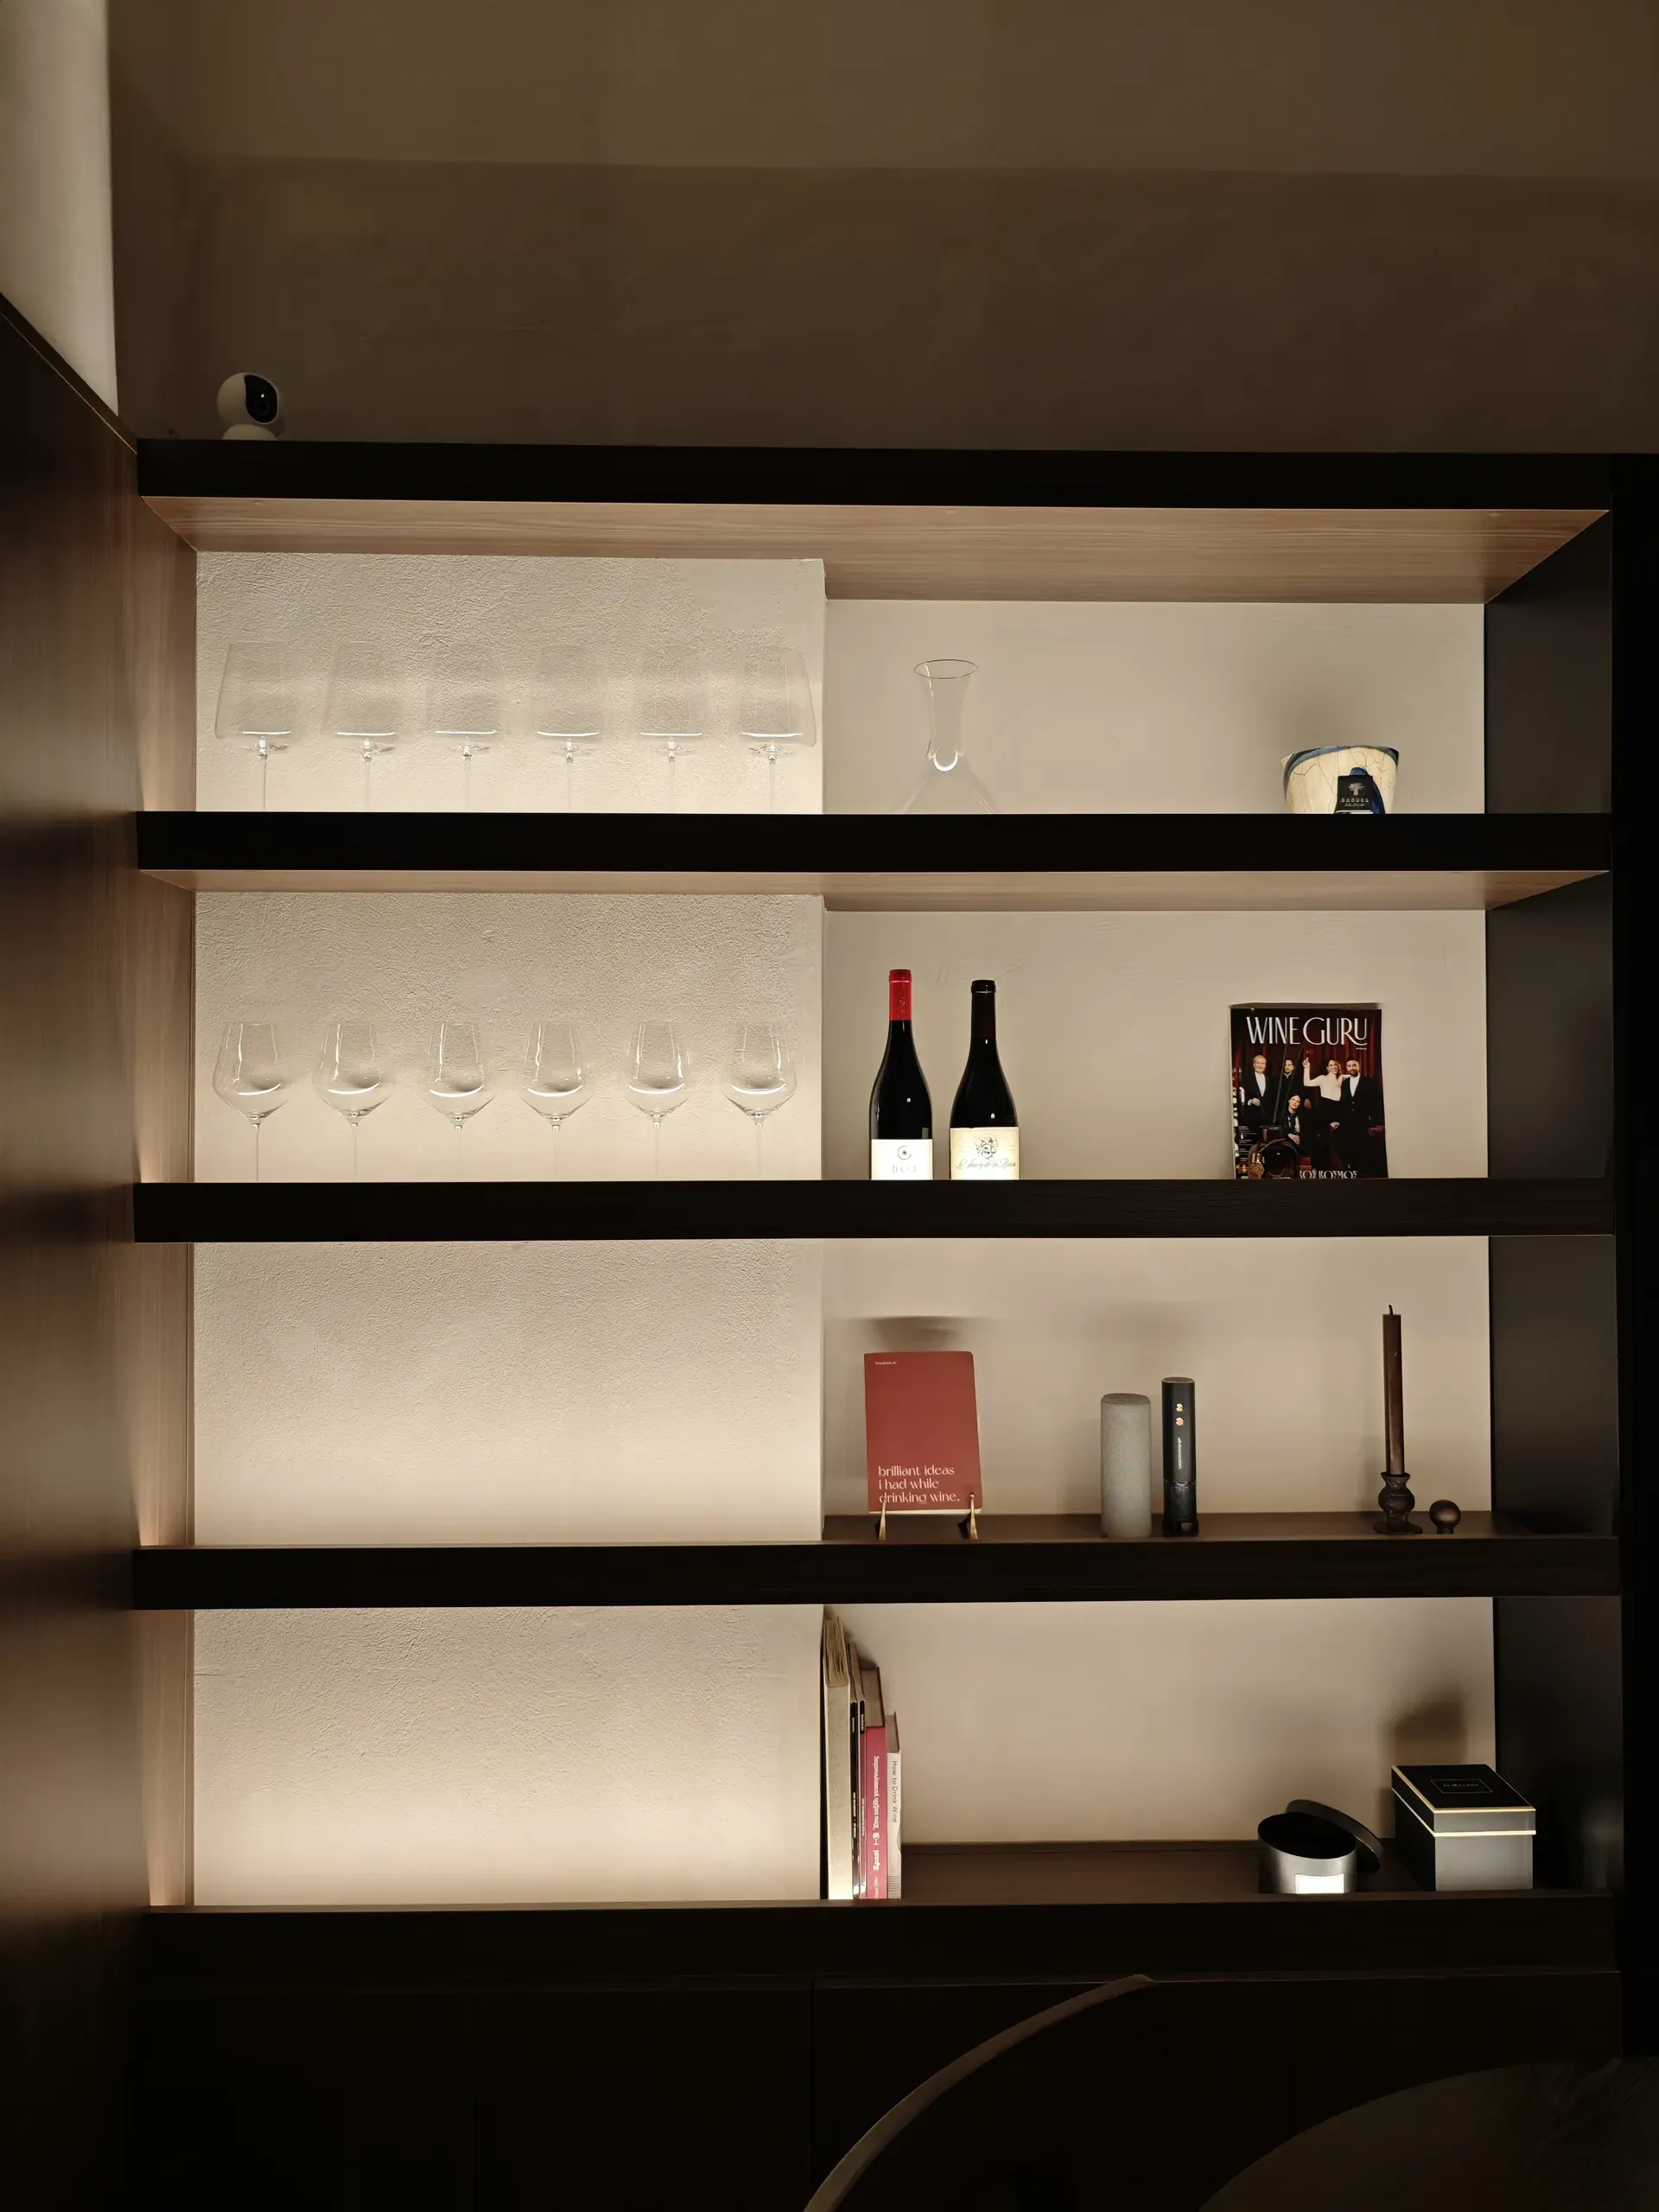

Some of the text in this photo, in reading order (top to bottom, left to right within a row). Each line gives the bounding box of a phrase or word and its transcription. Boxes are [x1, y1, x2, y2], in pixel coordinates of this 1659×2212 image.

[1246, 1016, 1368, 1046] WINE GURU
[878, 1464, 955, 1477] brilliant ideas
[879, 1477, 940, 1490] i had while
[879, 1491, 960, 1505] drinking wine.
